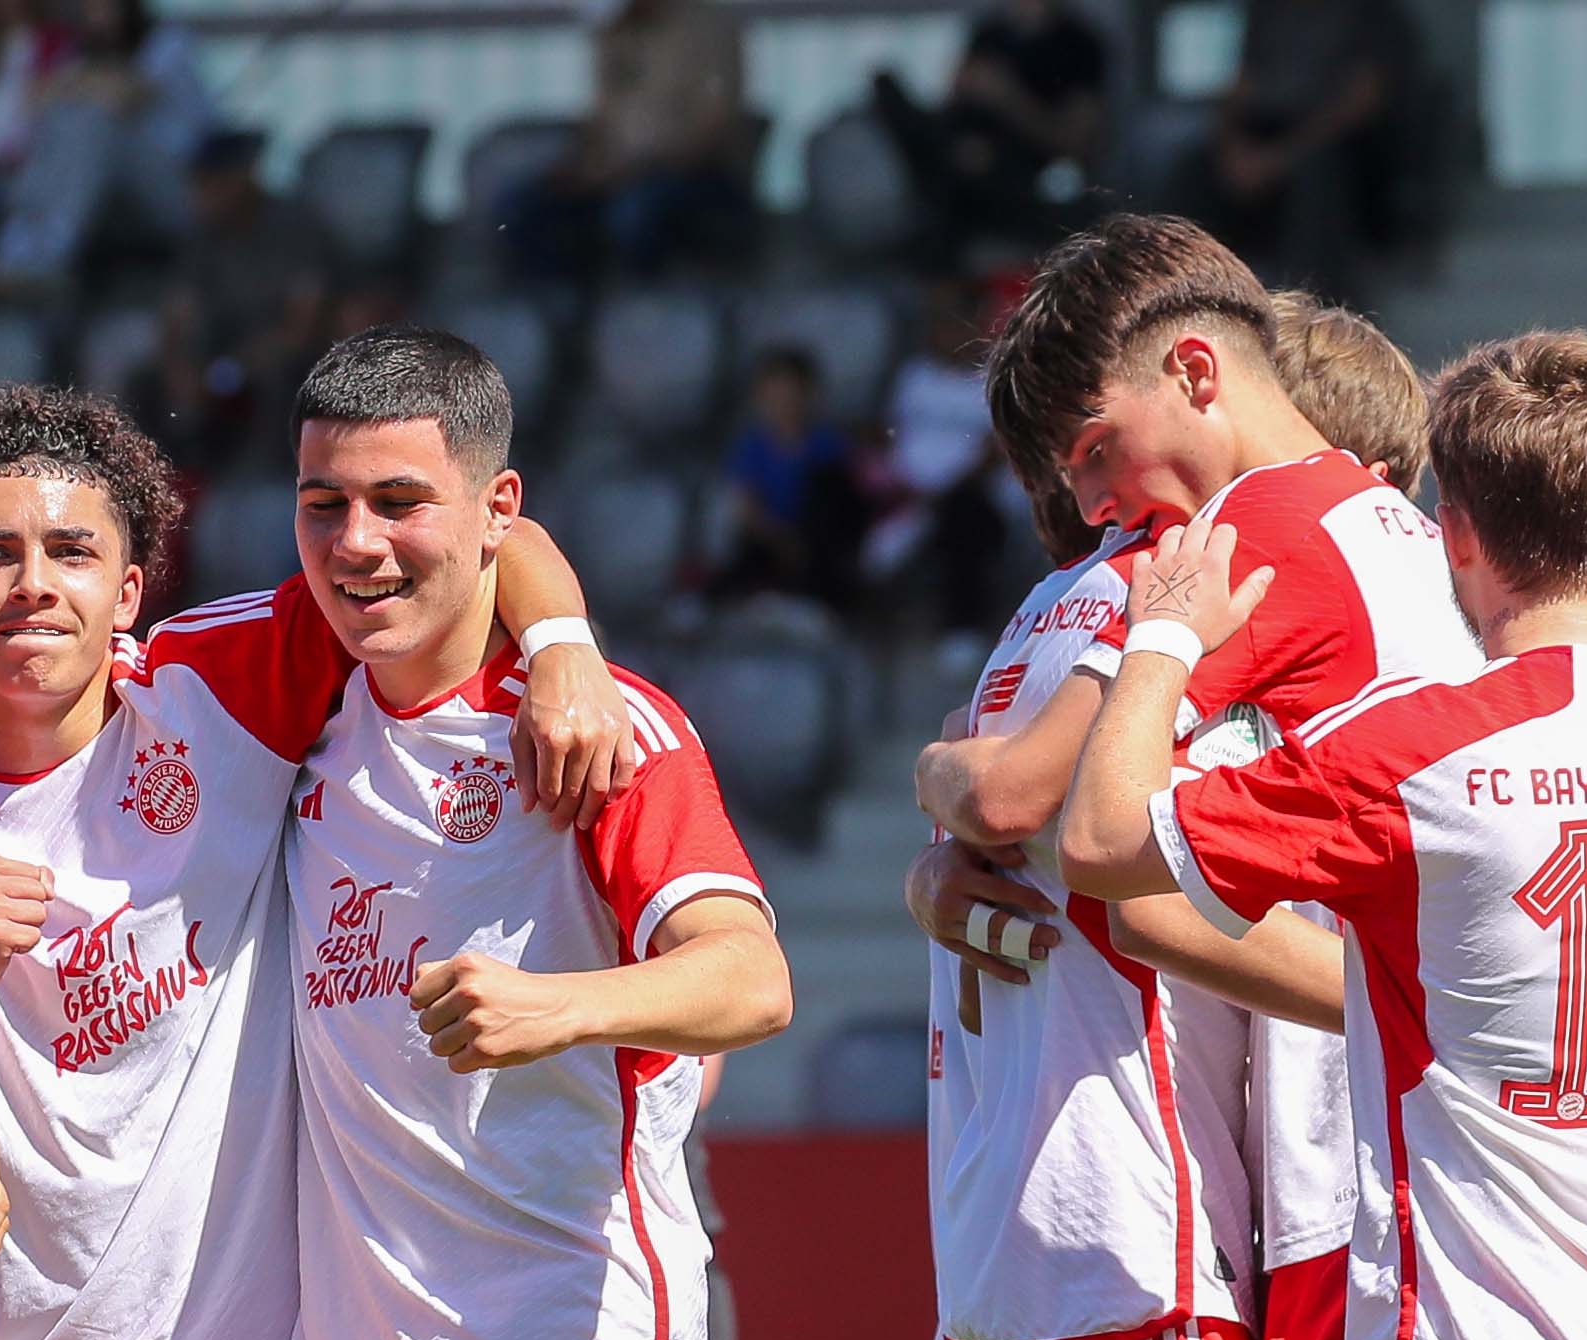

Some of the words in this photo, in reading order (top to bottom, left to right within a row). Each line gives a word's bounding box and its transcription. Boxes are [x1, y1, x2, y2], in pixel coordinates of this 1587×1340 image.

[143, 765, 185, 791] BAYERN
[443, 781, 458, 802] FC
[459, 777, 498, 803] BAYERN
[1466, 768, 1514, 806] FC
[141, 793, 152, 812] FC
[330, 876, 394, 935] ROT
[47, 901, 135, 991] ROT
[50, 920, 208, 1078] RASSISMUS
[63, 931, 145, 1024] GEGEN
